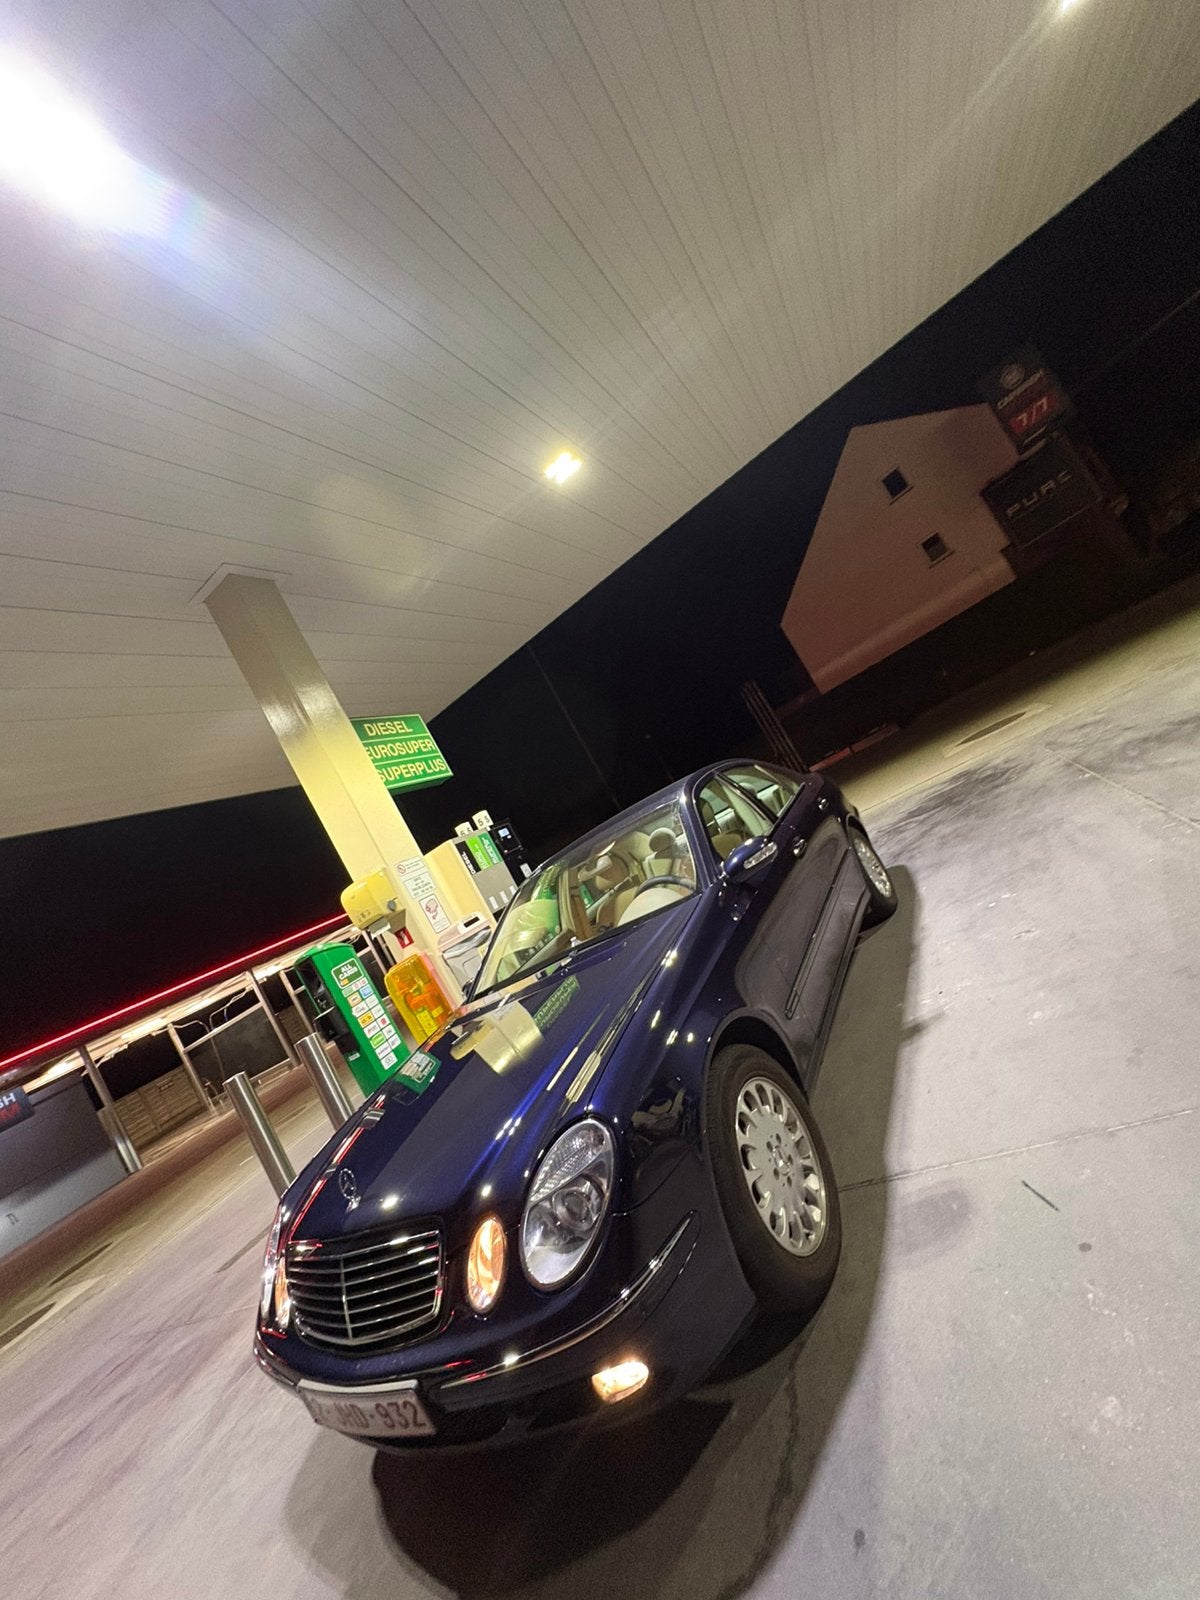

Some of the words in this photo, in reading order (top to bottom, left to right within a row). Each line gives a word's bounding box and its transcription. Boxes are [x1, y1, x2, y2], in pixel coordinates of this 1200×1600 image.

[363, 720, 413, 737] DIESEL
[364, 739, 436, 760] EUROSUPER
[377, 758, 447, 783] SUPERPLUS
[341, 963, 353, 973] ALL
